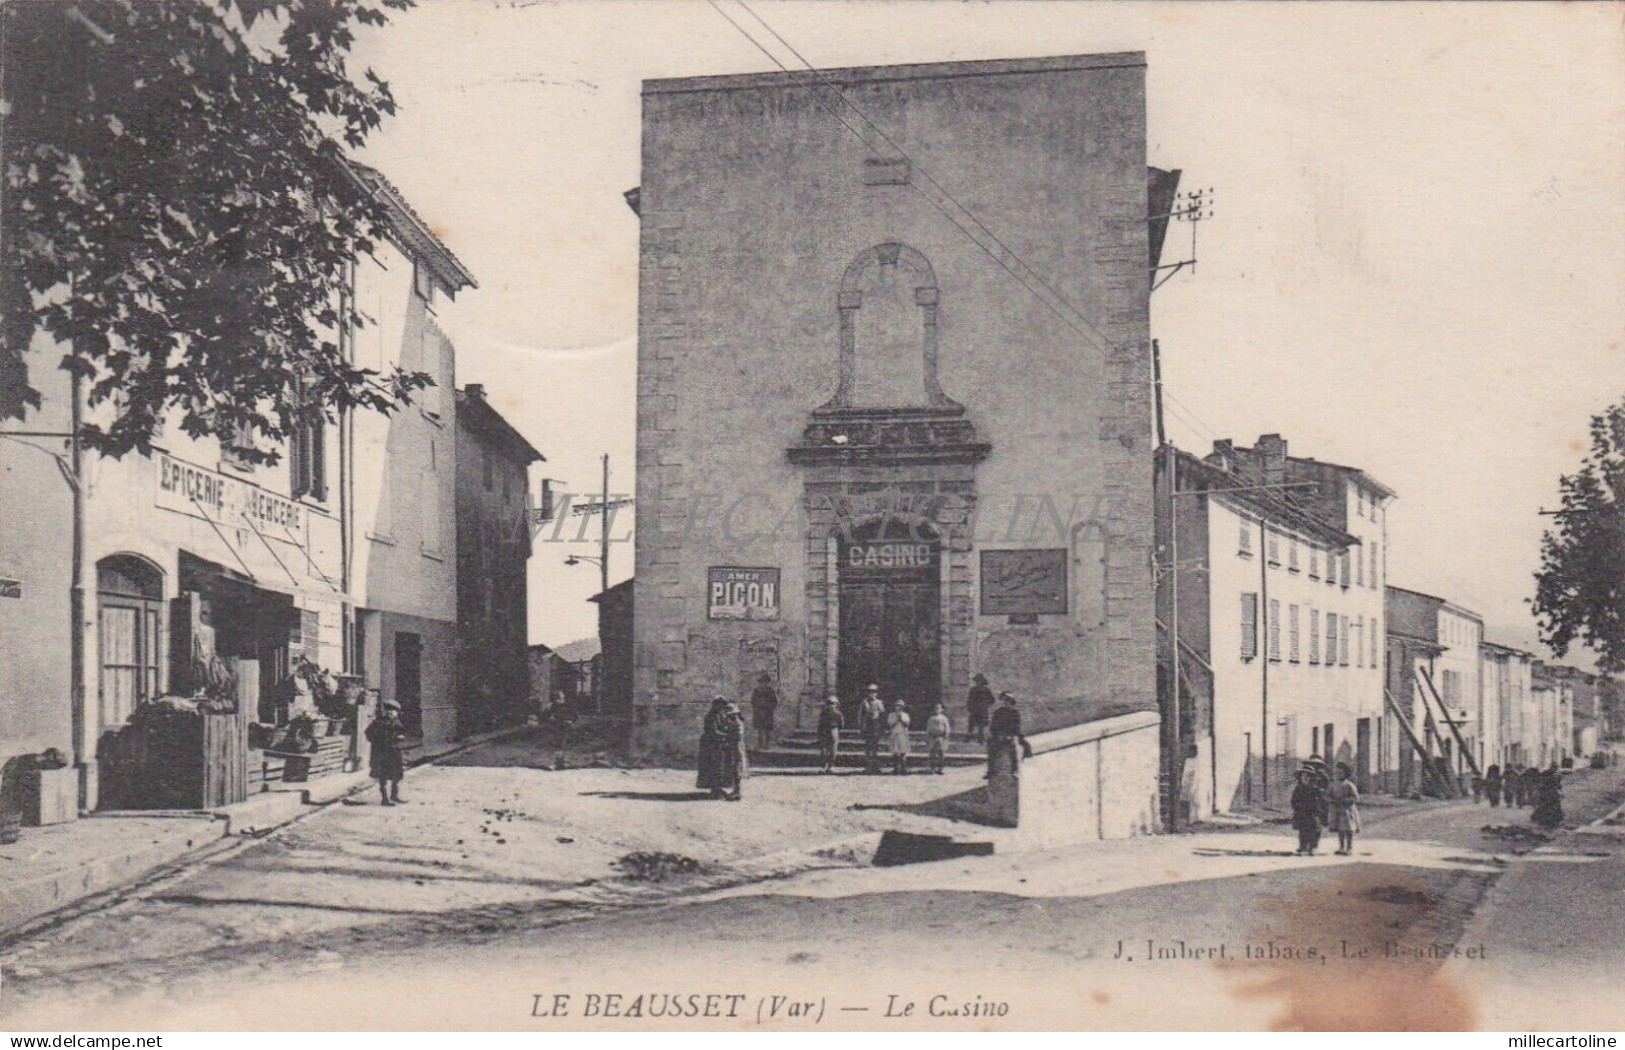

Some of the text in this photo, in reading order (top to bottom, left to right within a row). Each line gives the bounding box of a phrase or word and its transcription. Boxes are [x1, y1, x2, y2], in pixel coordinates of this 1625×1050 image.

[161, 456, 224, 509] EPICERIE
[849, 544, 930, 567] CASINO
[727, 572, 760, 581] AMER
[711, 581, 775, 608] PICON
